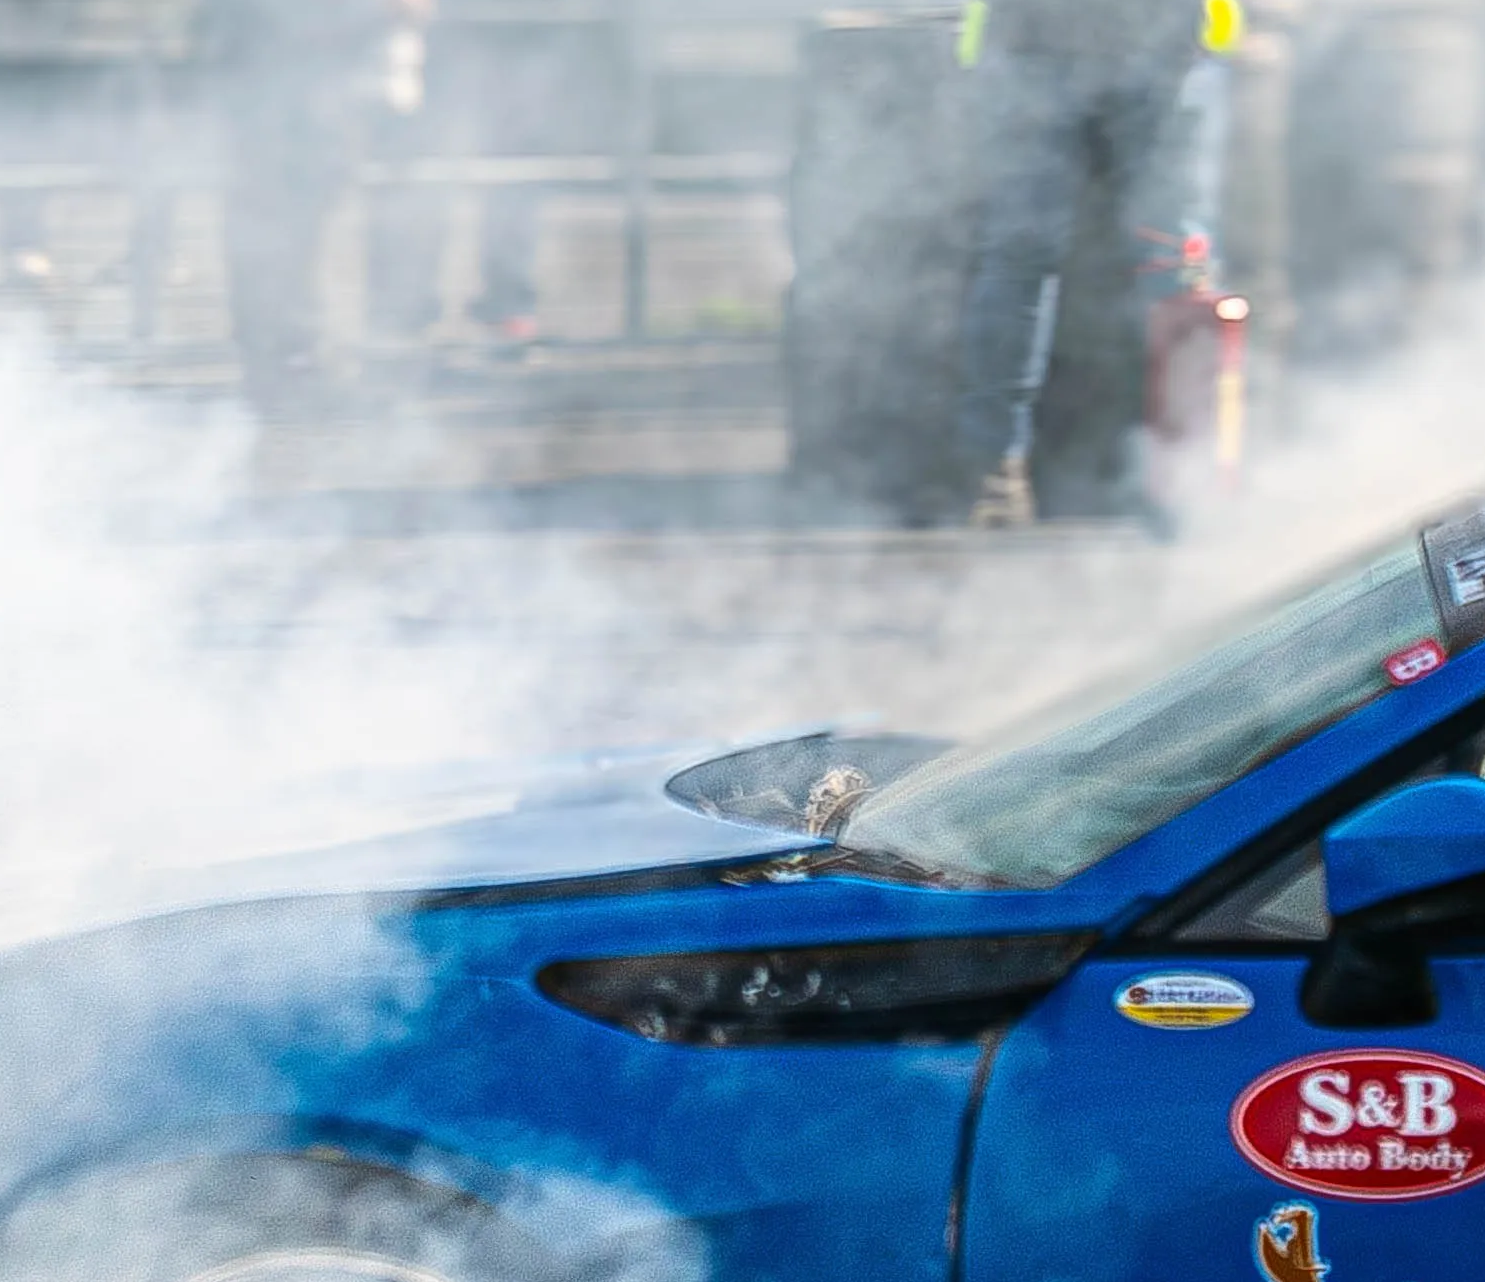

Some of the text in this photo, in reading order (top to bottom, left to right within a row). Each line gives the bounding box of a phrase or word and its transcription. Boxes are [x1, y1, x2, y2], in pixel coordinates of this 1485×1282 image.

[1298, 1068, 1459, 1137] S&B
[1284, 1136, 1472, 1181] Auto Body
